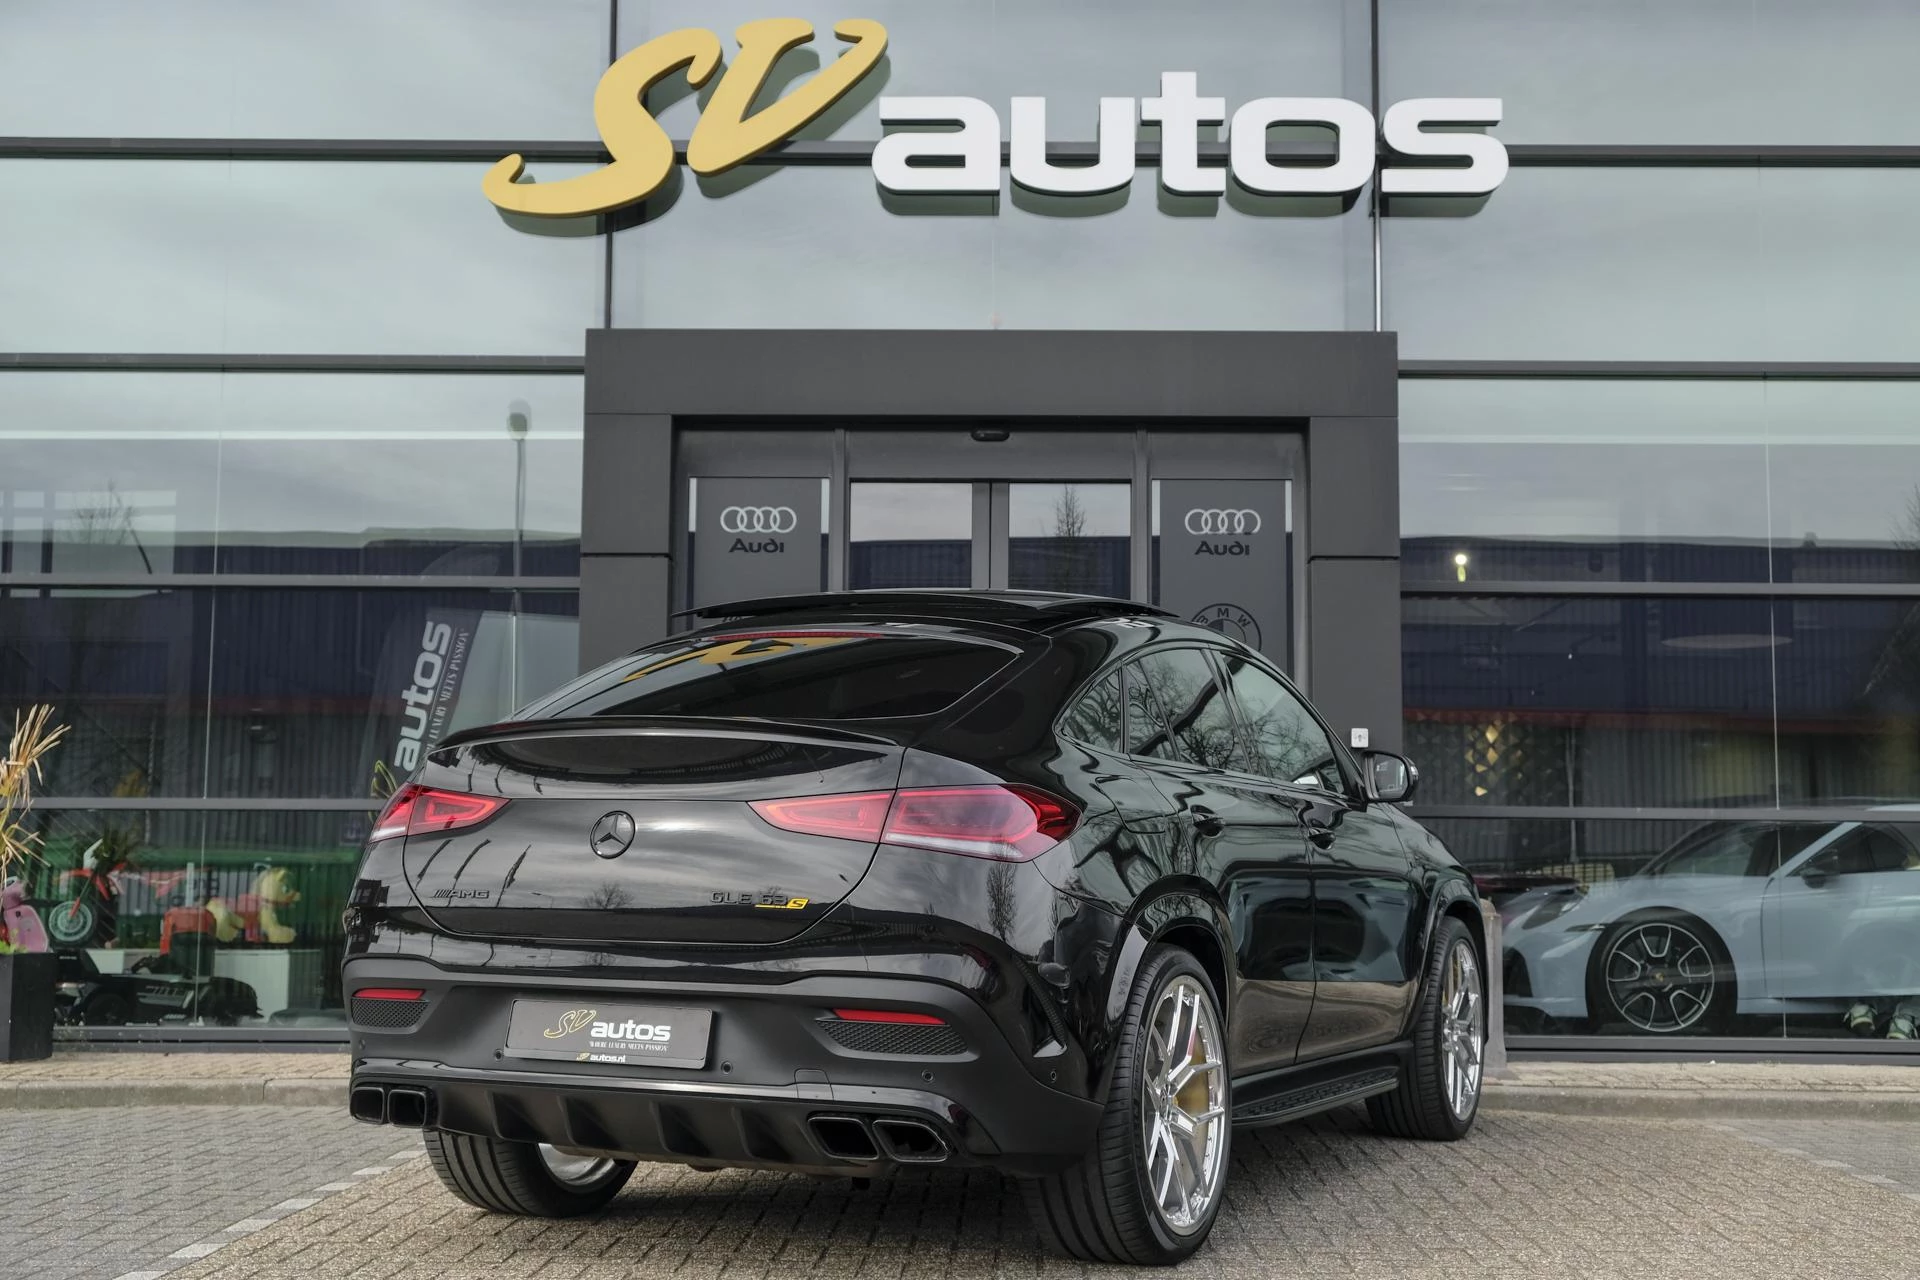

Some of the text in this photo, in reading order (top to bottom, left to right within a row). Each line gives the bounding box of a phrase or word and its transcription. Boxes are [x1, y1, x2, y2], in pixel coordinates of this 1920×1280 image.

[482, 18, 1509, 217] SV autos
[728, 538, 785, 553] Audi
[1195, 541, 1250, 556] Audi
[394, 621, 452, 772] autos
[429, 706, 447, 740] LUXURY
[440, 672, 457, 700] MEETS
[445, 889, 490, 899] AMG
[711, 891, 752, 904] GLE
[543, 1009, 672, 1042] SV autos
[589, 1054, 626, 1063] autos.nl
